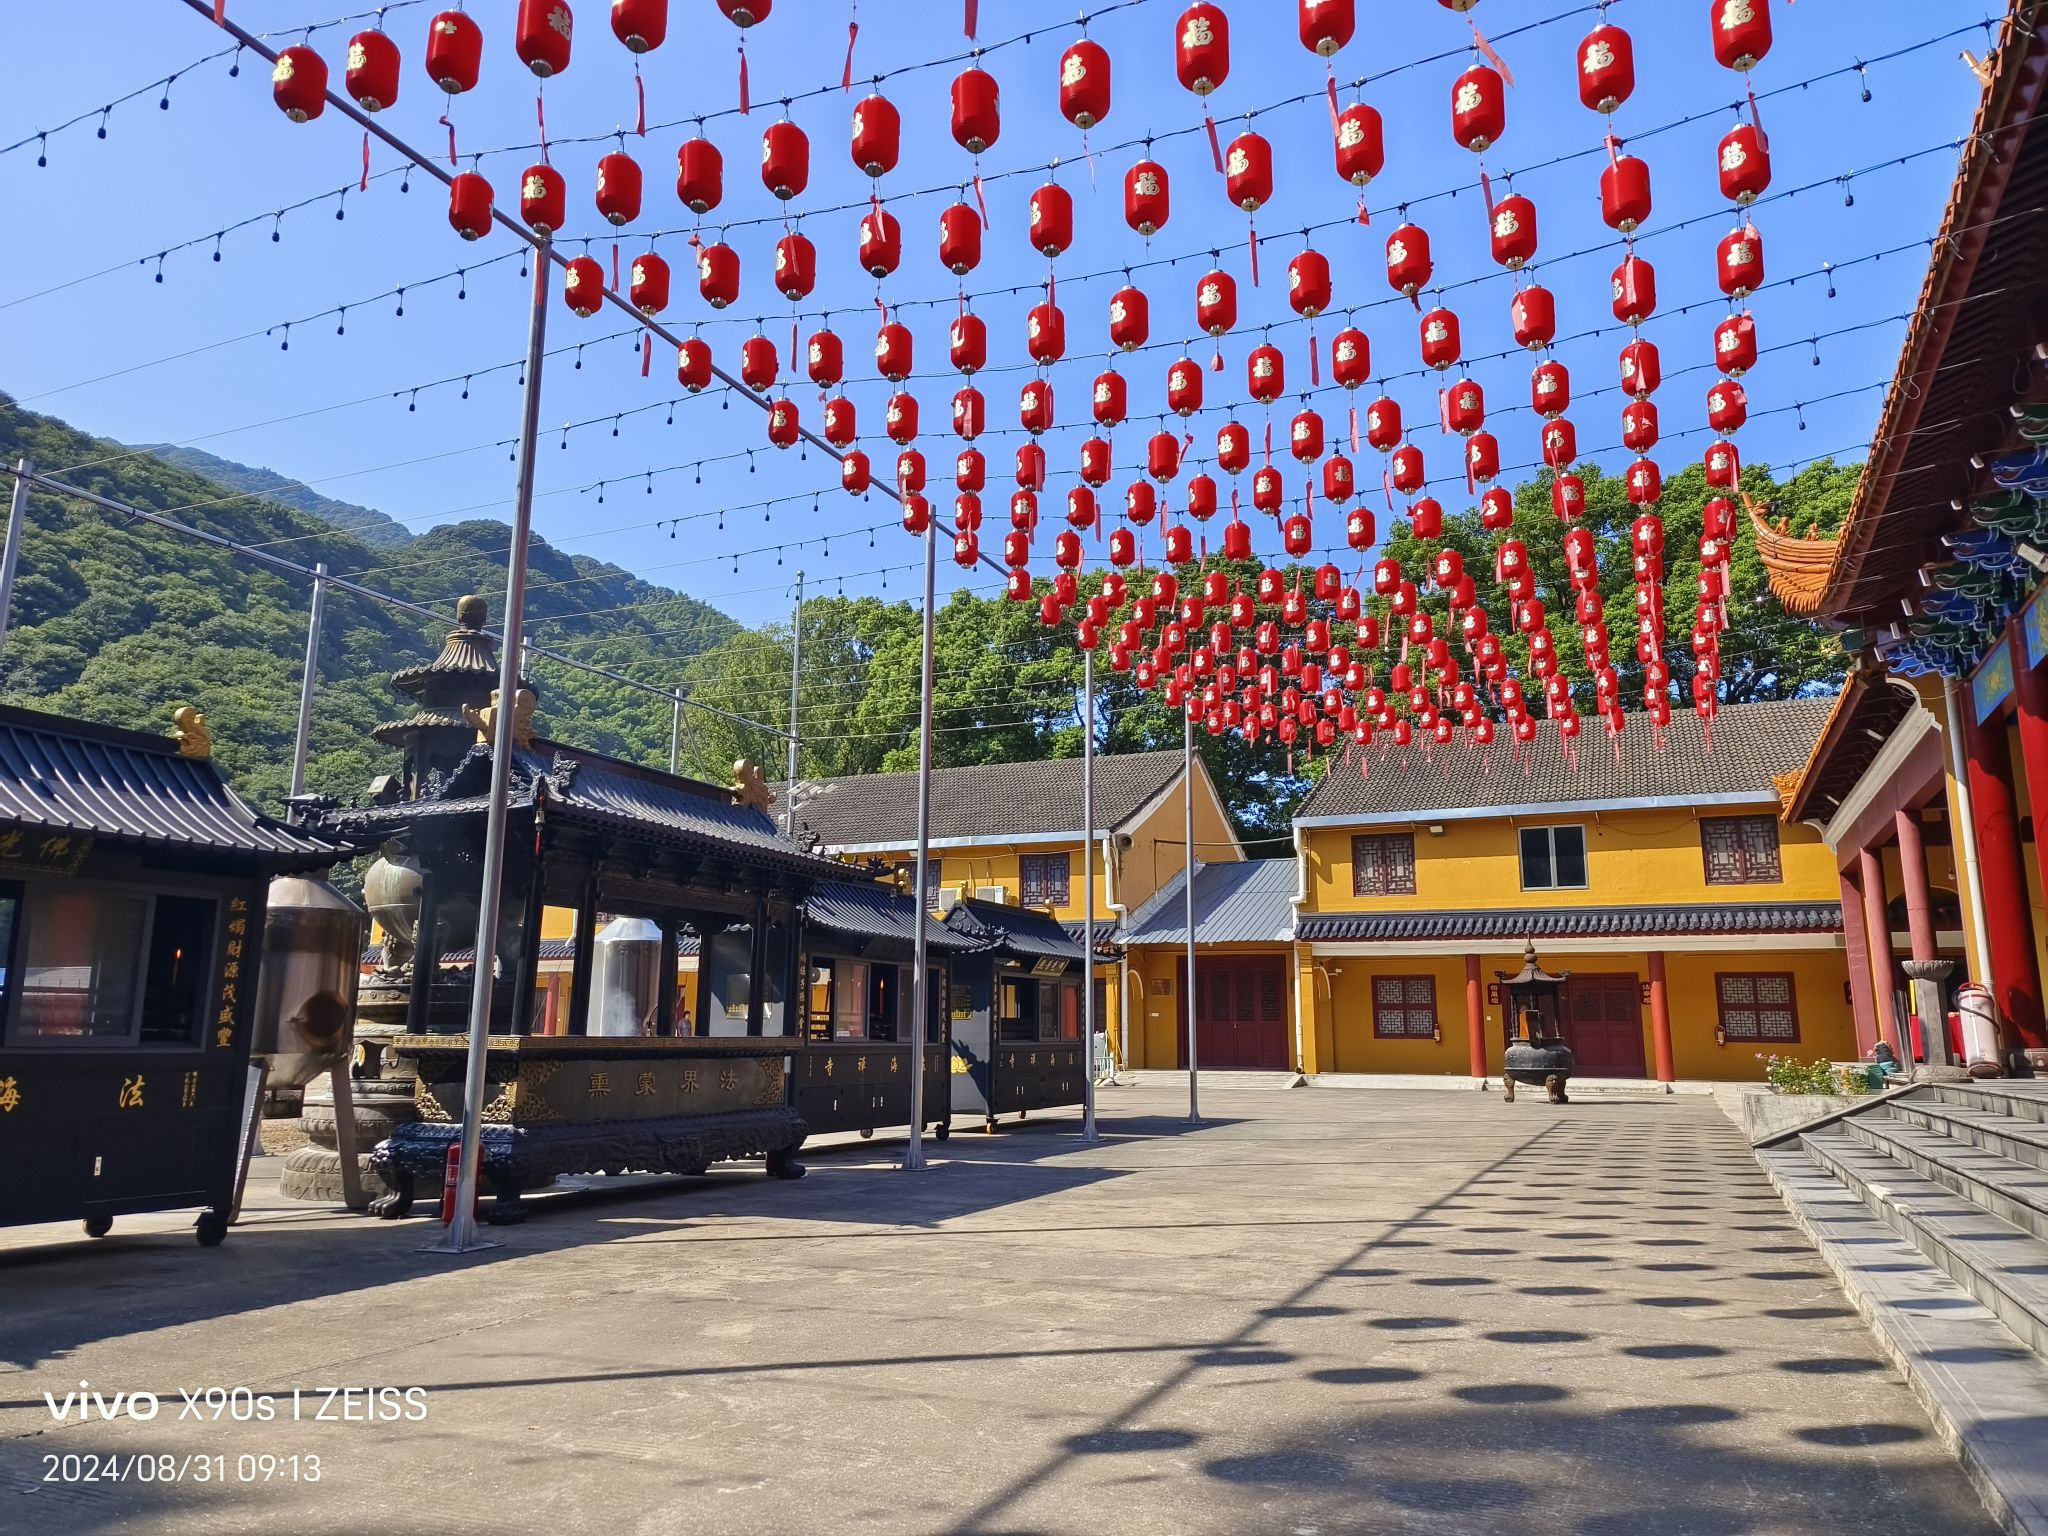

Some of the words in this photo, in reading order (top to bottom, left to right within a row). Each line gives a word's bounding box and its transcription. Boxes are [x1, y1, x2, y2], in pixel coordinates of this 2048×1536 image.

[547, 5, 572, 40] 福
[1720, 0, 1755, 30] 福
[1182, 17, 1214, 49] 福
[272, 54, 295, 83] 福
[1061, 54, 1086, 87] 福
[1584, 41, 1615, 73] 福
[1456, 82, 1482, 114] 福
[1338, 118, 1365, 149] 福
[1227, 148, 1249, 178] 福
[1721, 141, 1747, 171] 福
[522, 175, 547, 200] 福
[1134, 172, 1160, 196] 福
[1494, 209, 1519, 238] 福
[1388, 239, 1408, 267] 福
[1727, 242, 1753, 267] 福
[1199, 283, 1222, 307] 福
[1426, 320, 1448, 344] 福
[1717, 329, 1741, 353] 福
[1336, 340, 1357, 363] 福
[1169, 370, 1188, 392] 福
[1253, 357, 1273, 378] 福
[1535, 371, 1557, 395] 福
[1459, 392, 1479, 410] 福
